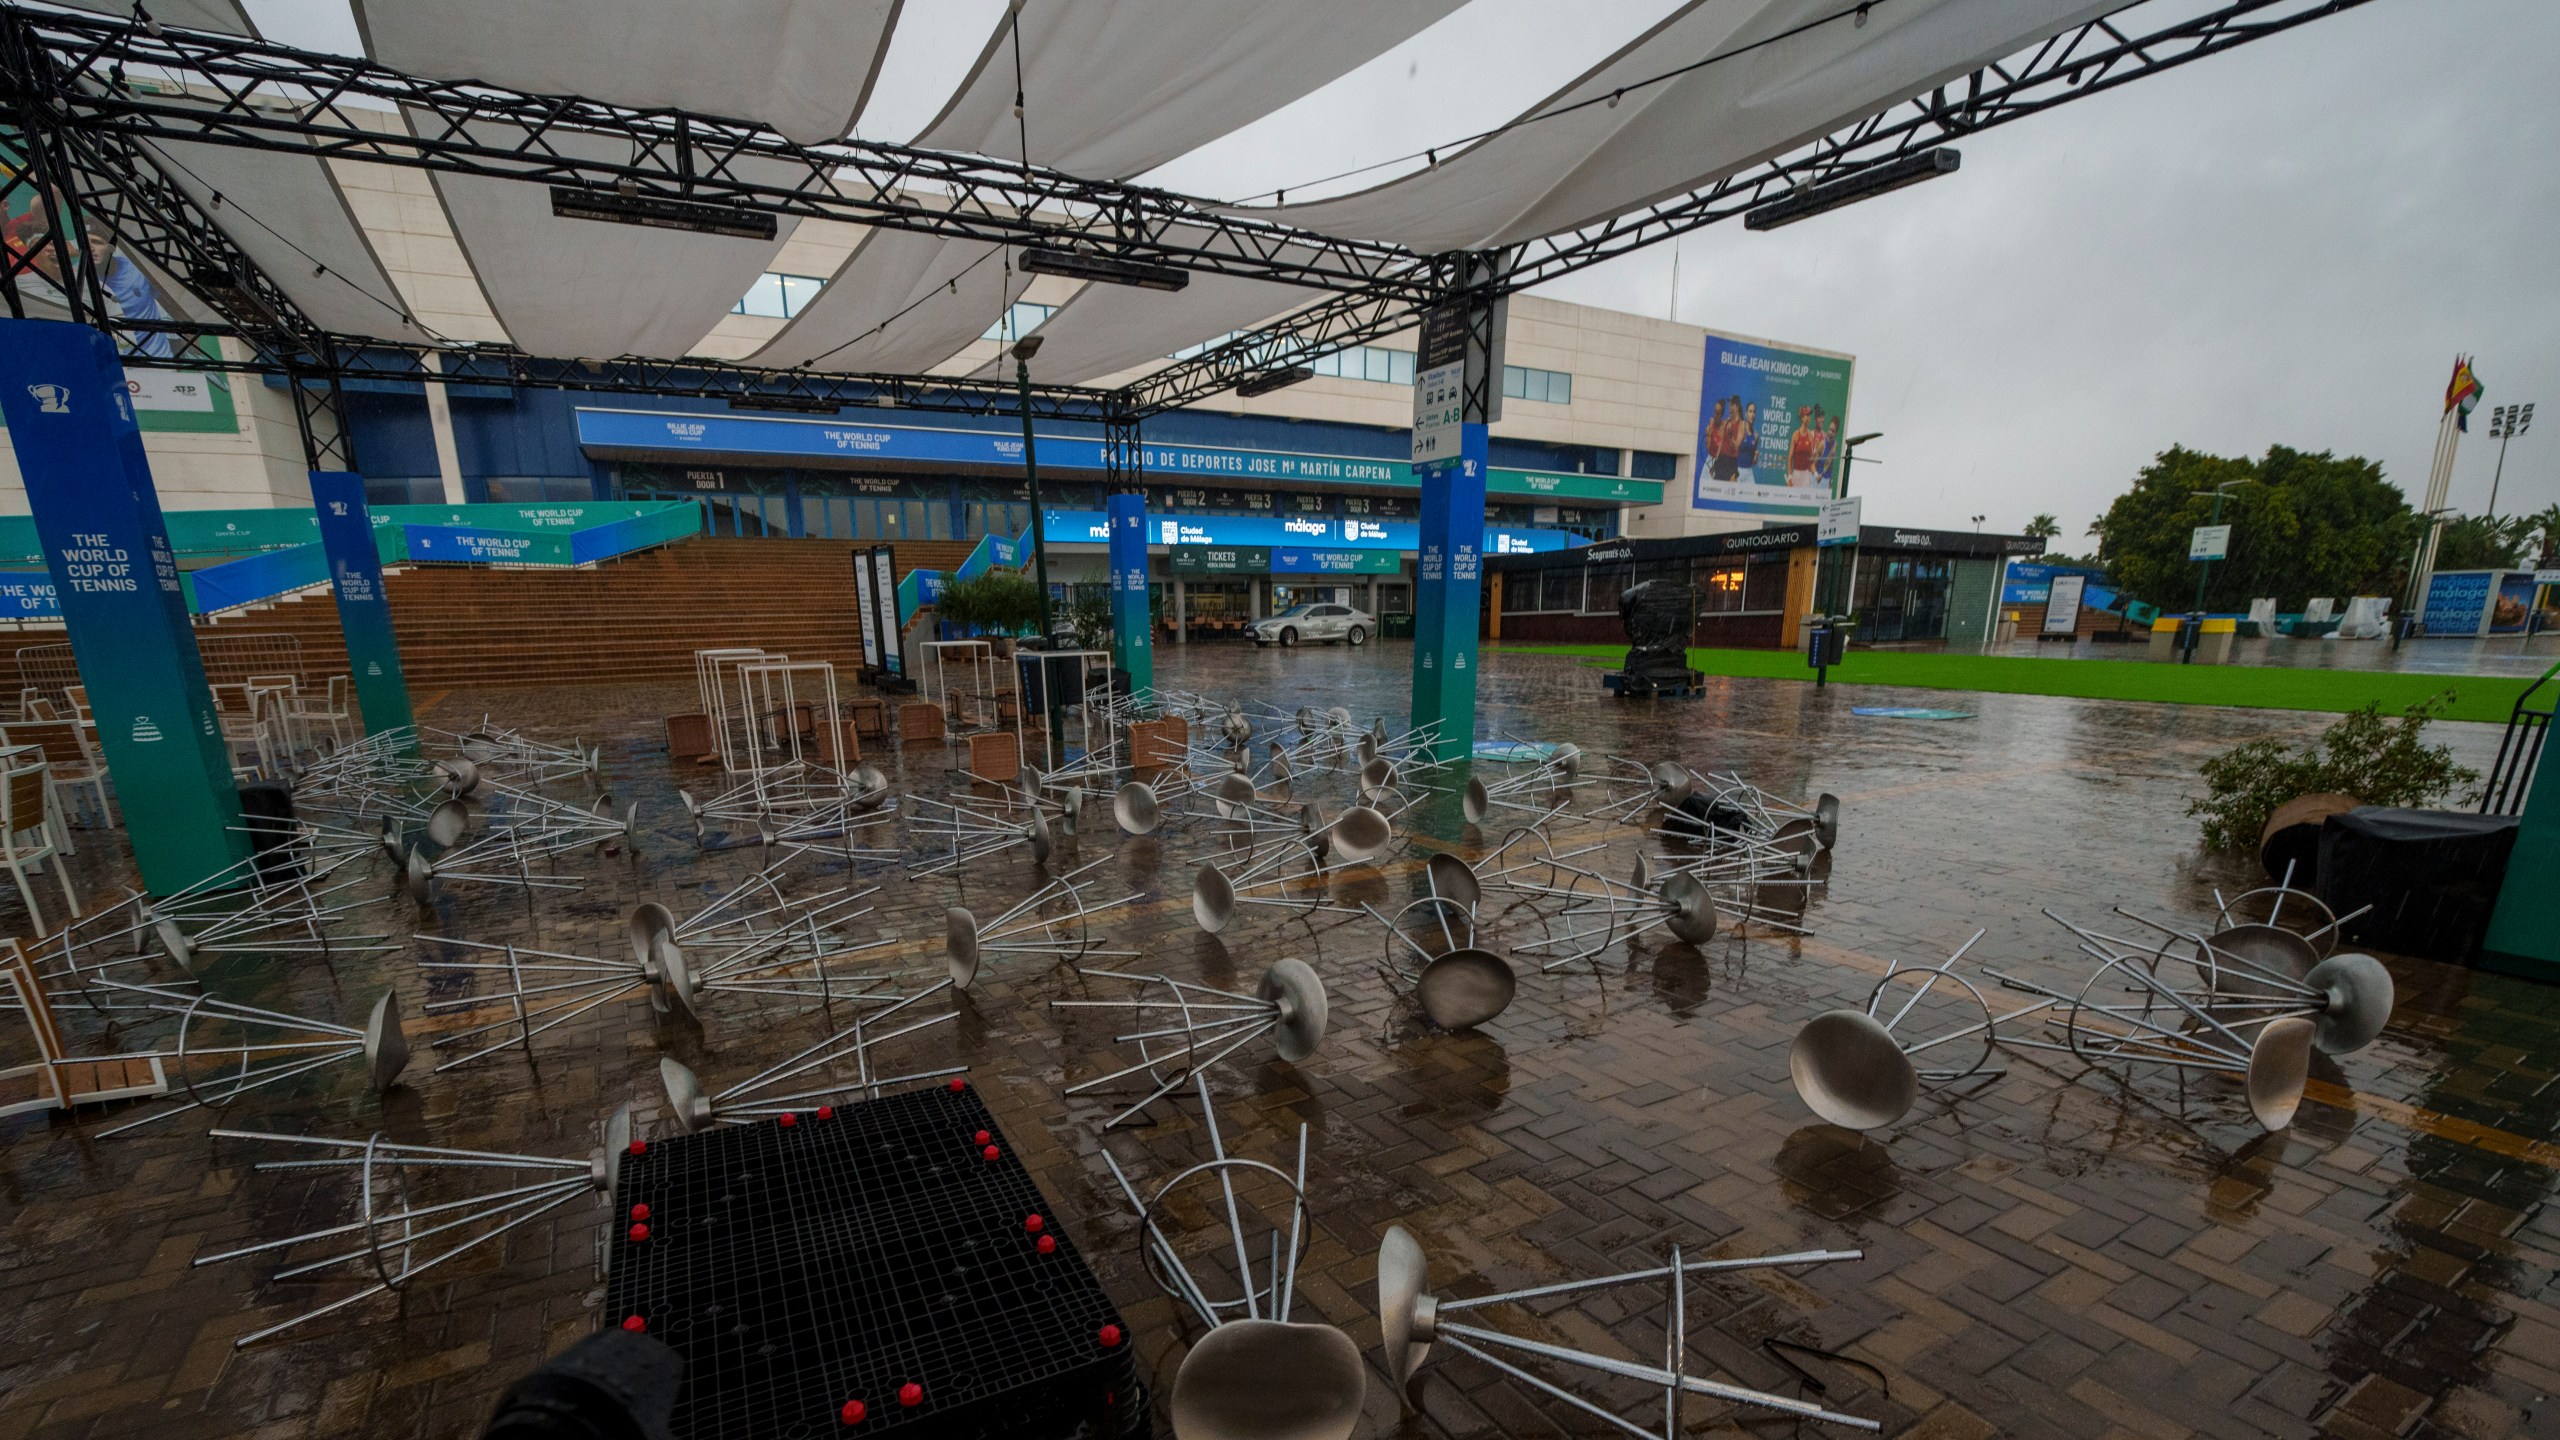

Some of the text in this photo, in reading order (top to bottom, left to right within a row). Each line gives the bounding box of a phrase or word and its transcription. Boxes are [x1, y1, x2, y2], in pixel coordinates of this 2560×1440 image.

[1721, 352, 1809, 377] BILLIE JEAN KING CUP
[1772, 396, 1787, 409] THE
[1763, 409, 1792, 424] WORLD
[1762, 423, 1790, 437] CUP OF
[824, 431, 891, 442] THE WORLD CUP
[836, 440, 880, 450] OF TENNIS
[1760, 436, 1789, 451] TENNIS
[1160, 452, 1176, 466] DE
[1182, 454, 1242, 471] DEPORTES
[1248, 458, 1276, 472] JOSE
[1282, 460, 1294, 474] Mª
[1300, 460, 1340, 477] MARTÍN
[1346, 464, 1392, 480] CARPENA
[687, 471, 714, 480] PUERTA
[696, 472, 724, 489] DOOR 1
[1177, 490, 1197, 498] PUERTA
[1183, 490, 1206, 506] DOOR 2
[1250, 494, 1271, 509] DOOR 3
[1316, 496, 1322, 511] 3
[1364, 499, 1370, 513] 3
[518, 508, 584, 518] THE WORLD CUP
[1576, 511, 1580, 522] 4
[371, 516, 390, 524] CUP
[532, 518, 576, 526] OF TENNIS
[1181, 526, 1203, 534] Ciudad
[1360, 522, 1380, 530] Ciudad
[72, 534, 110, 548] THE
[152, 536, 165, 548] THE
[456, 536, 530, 548] THE WORLD CUP
[1190, 535, 1212, 544] Málaga
[1727, 532, 1800, 550] QUINTOQUARTO
[1894, 530, 1920, 546] Seagram's
[1428, 546, 1438, 554] THE
[1460, 545, 1472, 554] THE
[2006, 540, 2044, 551] QUINTOQUARTO
[62, 549, 128, 562] WORLD
[152, 550, 172, 564] WORLD
[472, 547, 520, 558] OF TENNIS
[1207, 552, 1236, 562] TICKETS
[1312, 553, 1364, 562] THE WORLD CUP
[1424, 554, 1442, 562] WORLD
[1454, 554, 1477, 562] WORLD
[1587, 548, 1618, 562] Seagram's
[68, 564, 130, 578] CUP OF
[156, 565, 168, 578] CUP
[1331, 562, 1354, 570] TENNIS
[1422, 563, 1434, 572] CUP
[1454, 562, 1476, 570] CUP OF
[1422, 572, 1442, 580] TENNIS
[1453, 572, 1476, 580] TENNIS
[0, 585, 27, 596] HE
[70, 579, 138, 592] TENNIS
[158, 579, 180, 592] TENNIS
[20, 598, 42, 610] OF
